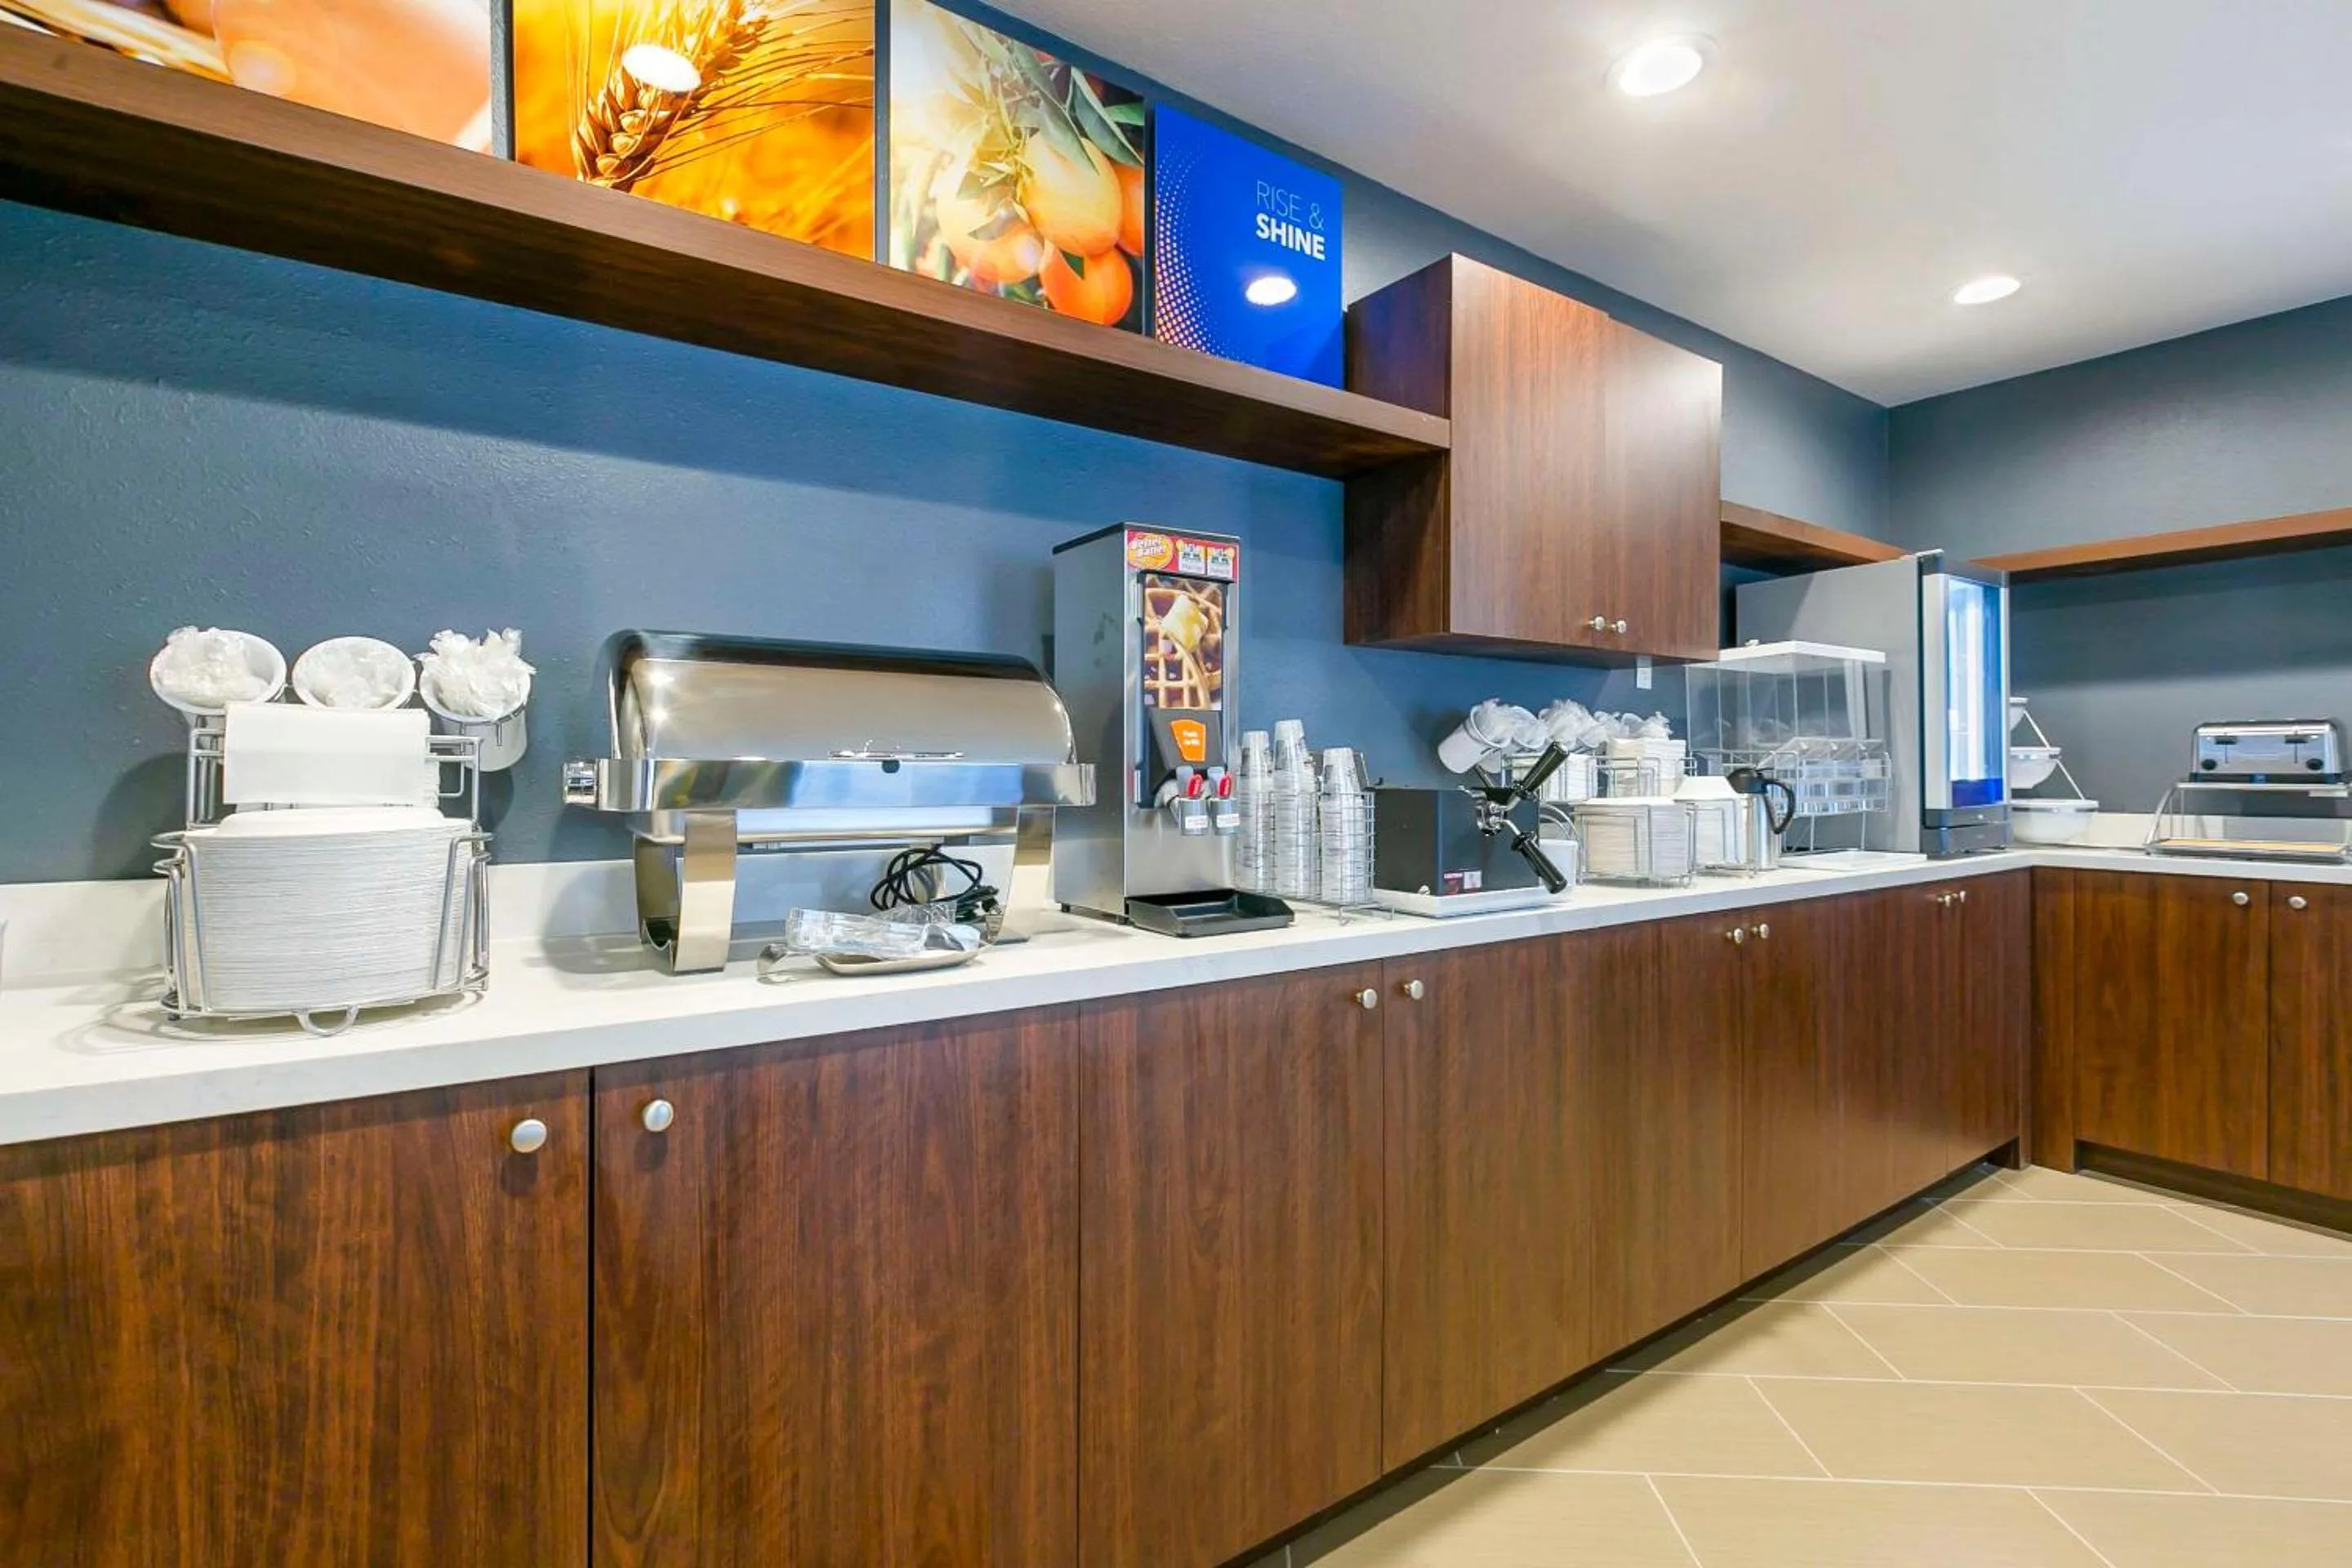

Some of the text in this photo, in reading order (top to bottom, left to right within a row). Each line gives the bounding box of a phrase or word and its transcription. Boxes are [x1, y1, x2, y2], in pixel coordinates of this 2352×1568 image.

[1257, 180, 1325, 231] RISE &
[1256, 213, 1325, 261] SHINE
